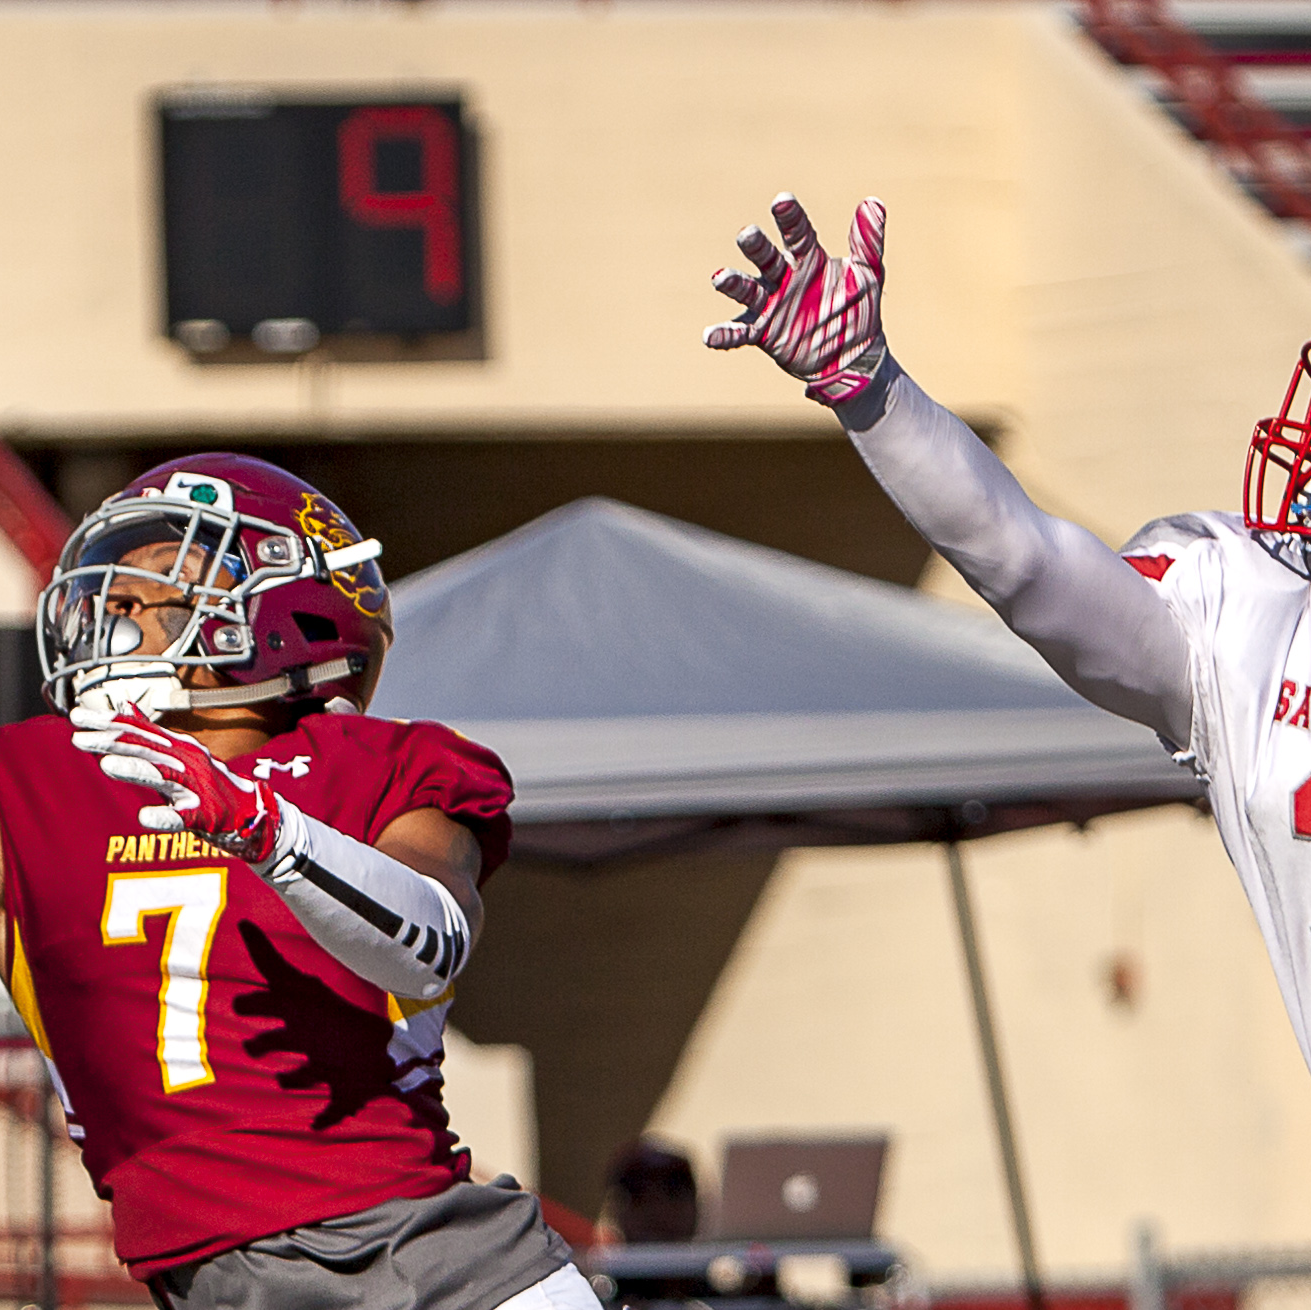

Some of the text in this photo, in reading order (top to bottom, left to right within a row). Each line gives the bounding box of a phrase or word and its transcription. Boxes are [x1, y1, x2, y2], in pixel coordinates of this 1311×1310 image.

[336, 104, 464, 306] 9
[105, 830, 231, 862] PANTHE
[99, 866, 228, 1095] 7
